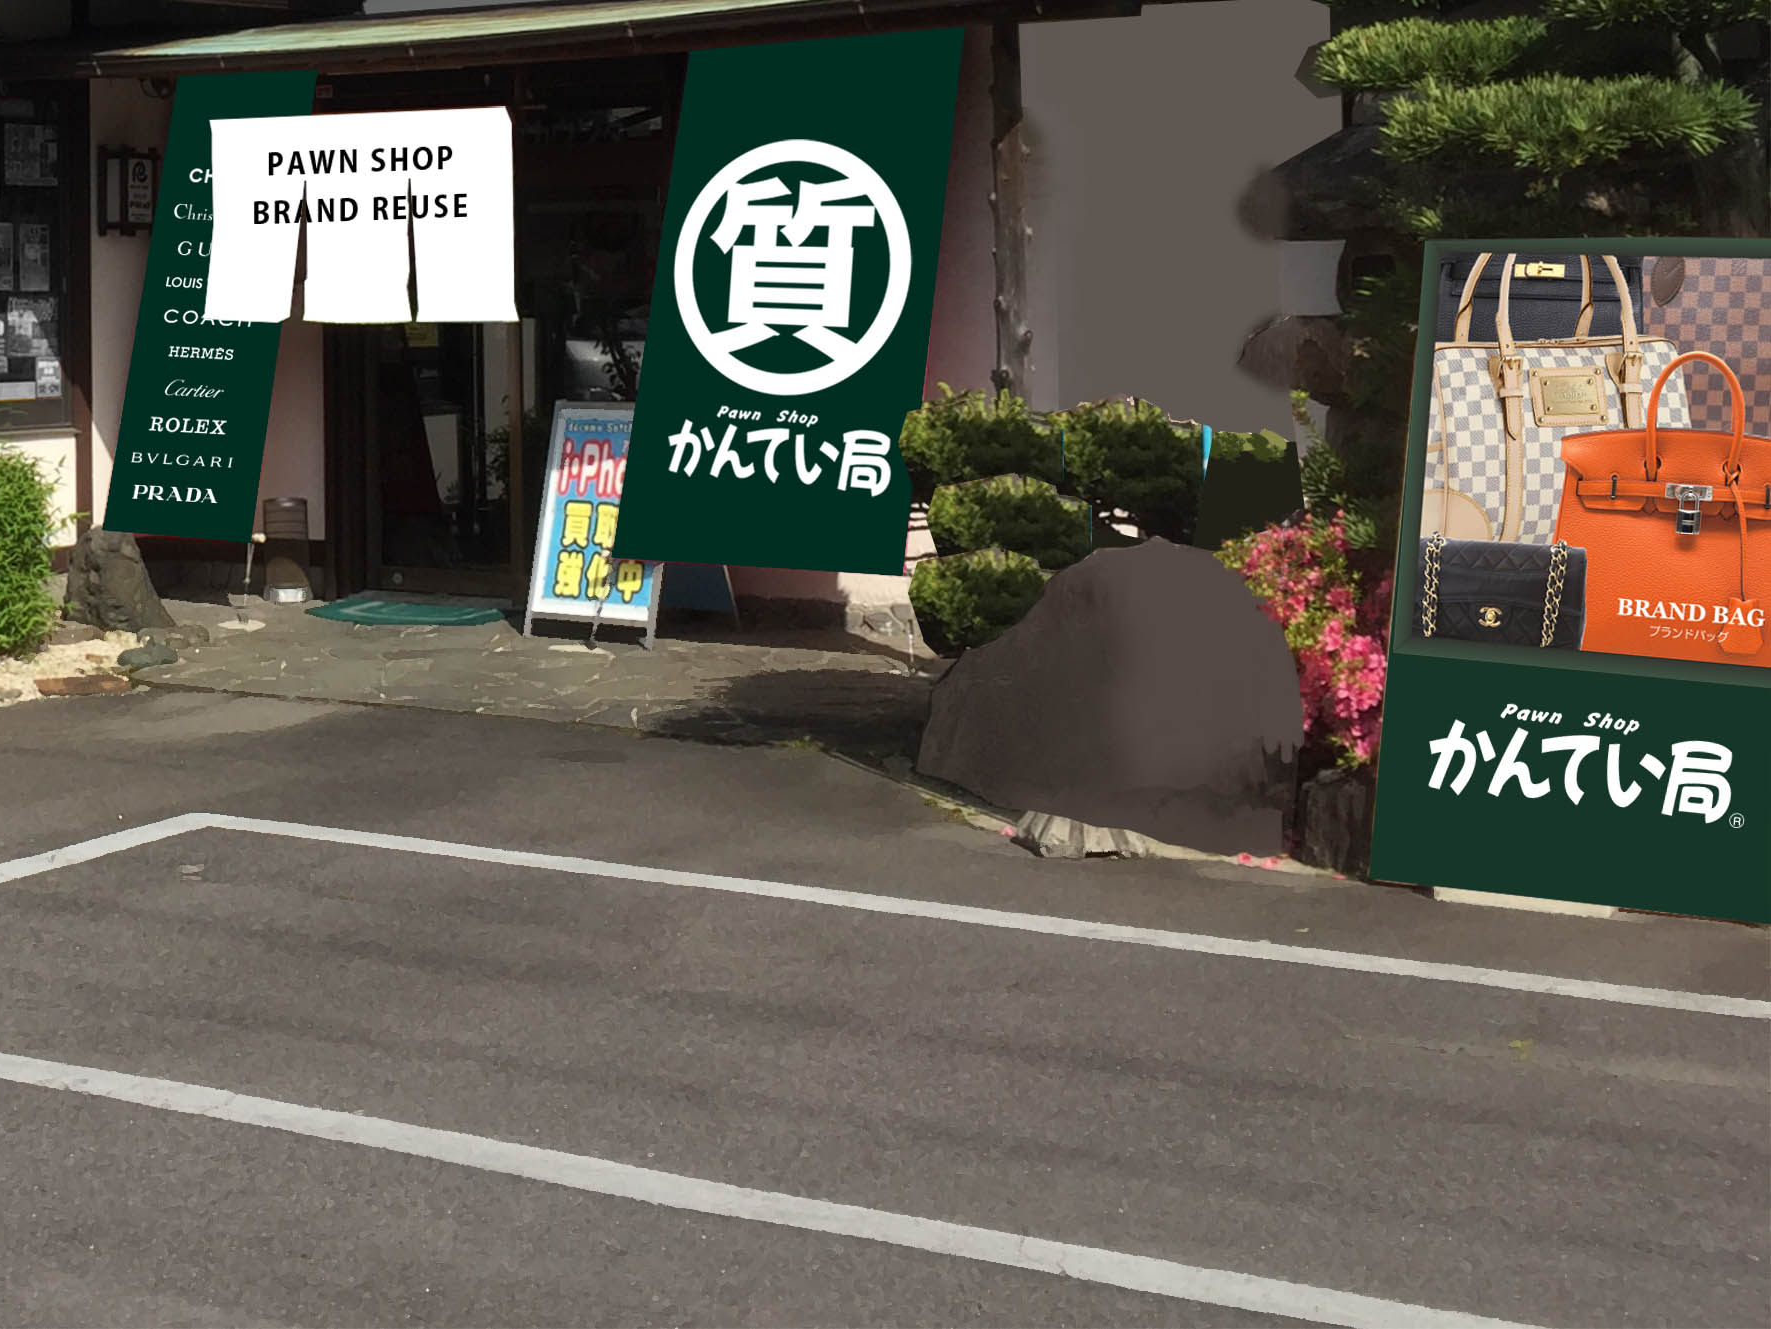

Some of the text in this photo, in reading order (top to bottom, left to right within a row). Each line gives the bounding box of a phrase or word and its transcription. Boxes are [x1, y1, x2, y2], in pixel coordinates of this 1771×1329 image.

[268, 145, 453, 176] PAWN SHOP
[254, 193, 468, 224] BRAND REUSE
[704, 170, 882, 368] 質
[165, 276, 204, 289] LOUIS
[164, 378, 225, 399] Cartier
[148, 416, 227, 435] ROLEX
[716, 405, 819, 428] Pawn Shop
[131, 451, 233, 469] BVLGARI
[668, 419, 892, 497] かんてい局
[132, 484, 218, 504] PRADA
[1617, 597, 1765, 627] BRAND BAG
[1649, 625, 1730, 643] ブランドバッグ
[1500, 703, 1640, 735] Pawn Shop
[1428, 719, 1733, 824] かんてい局
